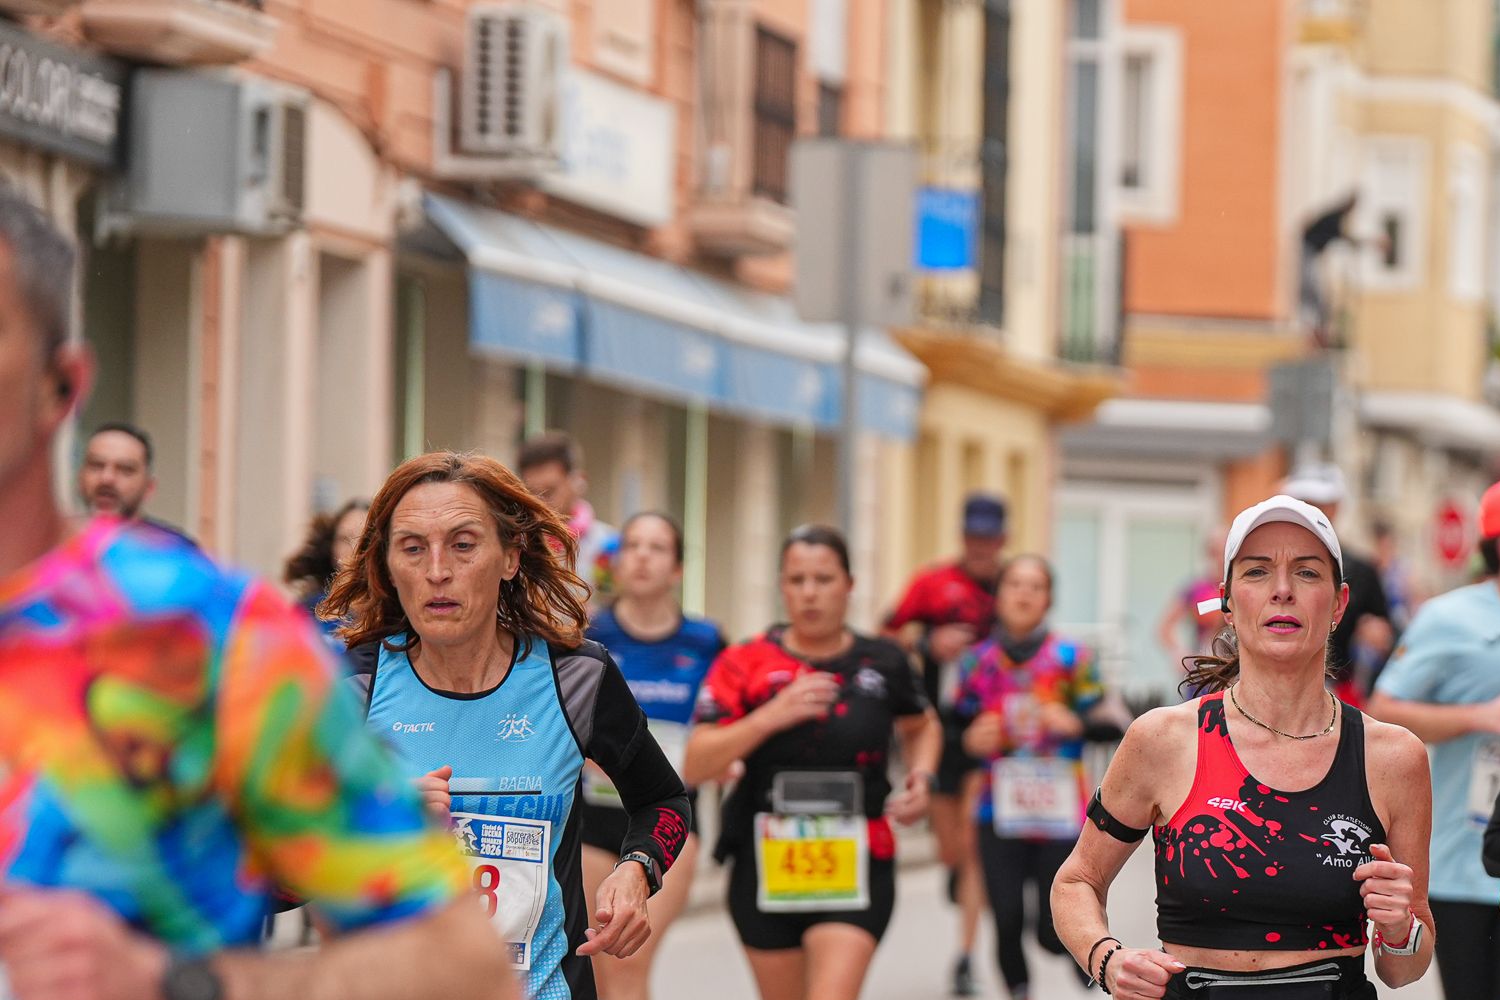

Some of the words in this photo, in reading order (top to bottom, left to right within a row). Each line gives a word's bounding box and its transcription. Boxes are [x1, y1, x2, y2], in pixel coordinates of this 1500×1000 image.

[403, 722, 436, 734] TACTIC
[500, 776, 543, 791] BAENA
[1207, 797, 1248, 812] 42K
[1323, 814, 1337, 825] CLUB
[1346, 816, 1373, 833] ATLETISMO
[506, 836, 540, 846] populares
[507, 831, 535, 839] carreras
[480, 844, 502, 857] 2026
[781, 842, 838, 878] 455
